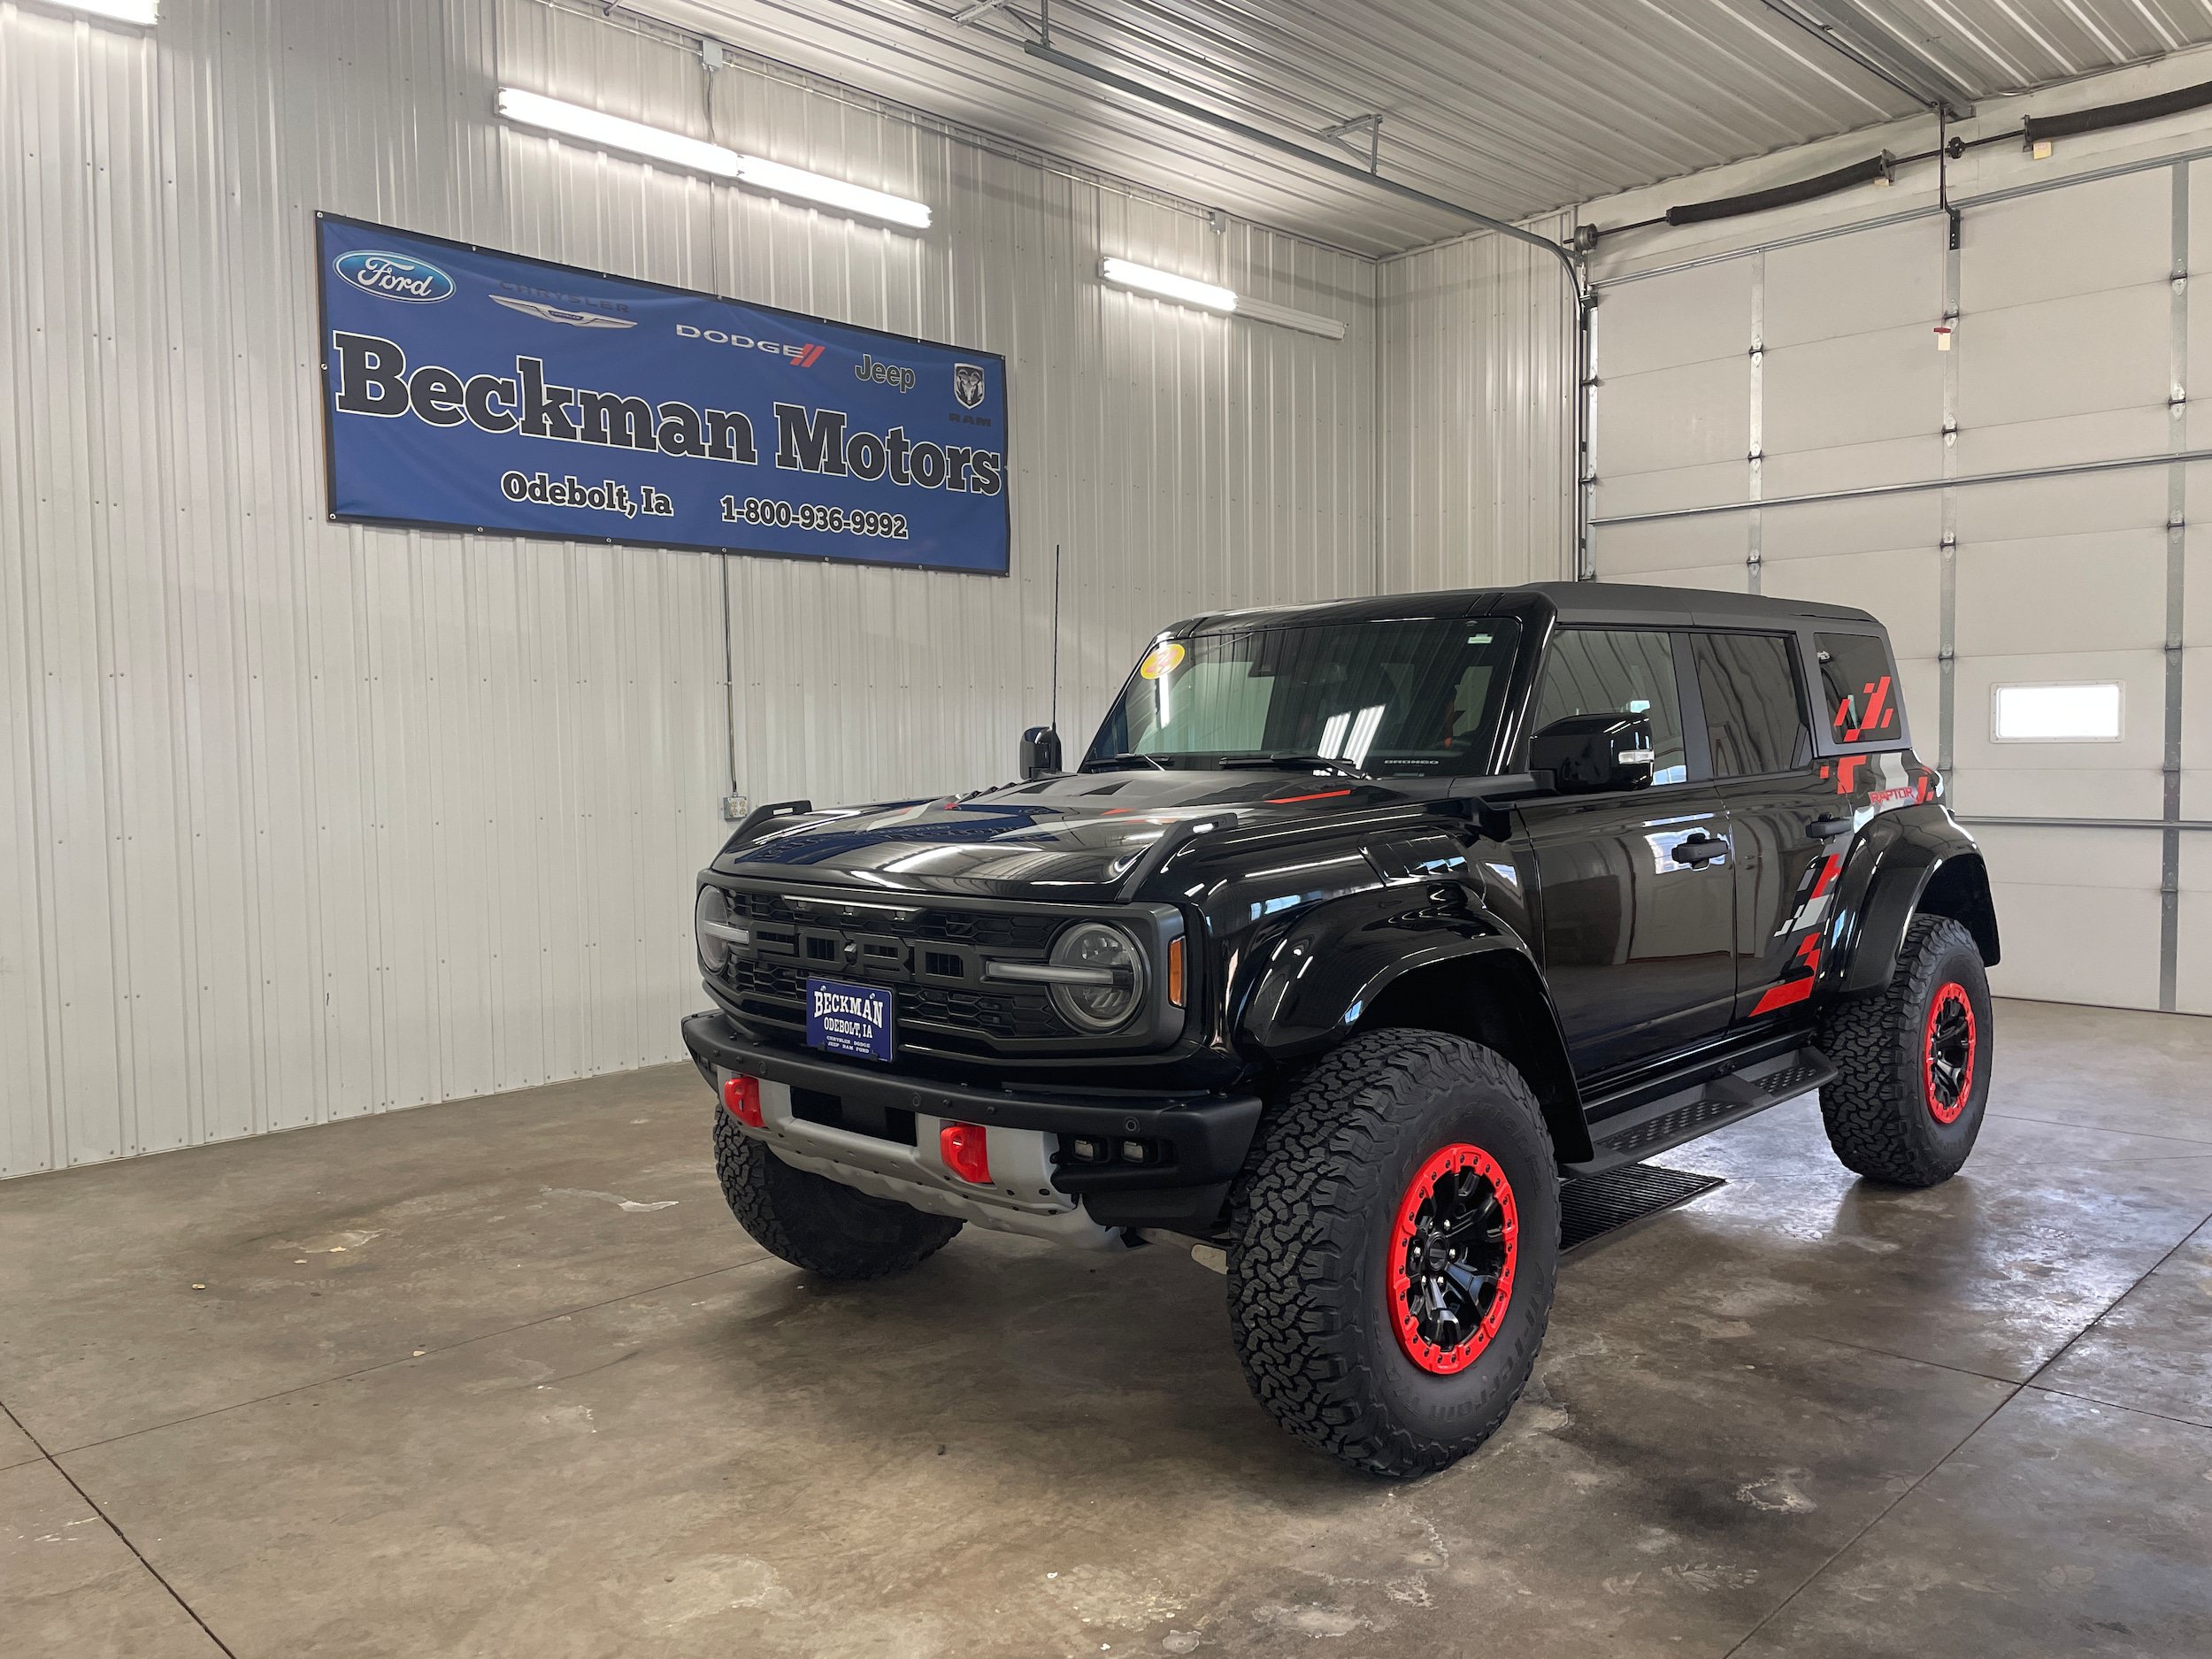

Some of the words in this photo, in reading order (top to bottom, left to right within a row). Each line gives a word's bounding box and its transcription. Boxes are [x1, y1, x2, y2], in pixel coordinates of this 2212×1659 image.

[357, 255, 434, 297] Ford
[499, 280, 630, 313] CHRYSLER
[675, 323, 805, 358] DODGE
[854, 353, 916, 394] Jeep
[333, 329, 758, 465] Beckman
[772, 401, 1002, 496] Motors
[948, 411, 992, 427] RAM
[500, 469, 637, 519] Odebolt,
[641, 486, 674, 518] Ia
[719, 494, 910, 540] 1-800-936-9992
[1869, 787, 1916, 804] RAPTOR
[749, 920, 977, 991] FORD
[814, 990, 884, 1029] BECKMAN
[824, 1016, 862, 1039] ODEBOLT,
[862, 1024, 873, 1039] IA
